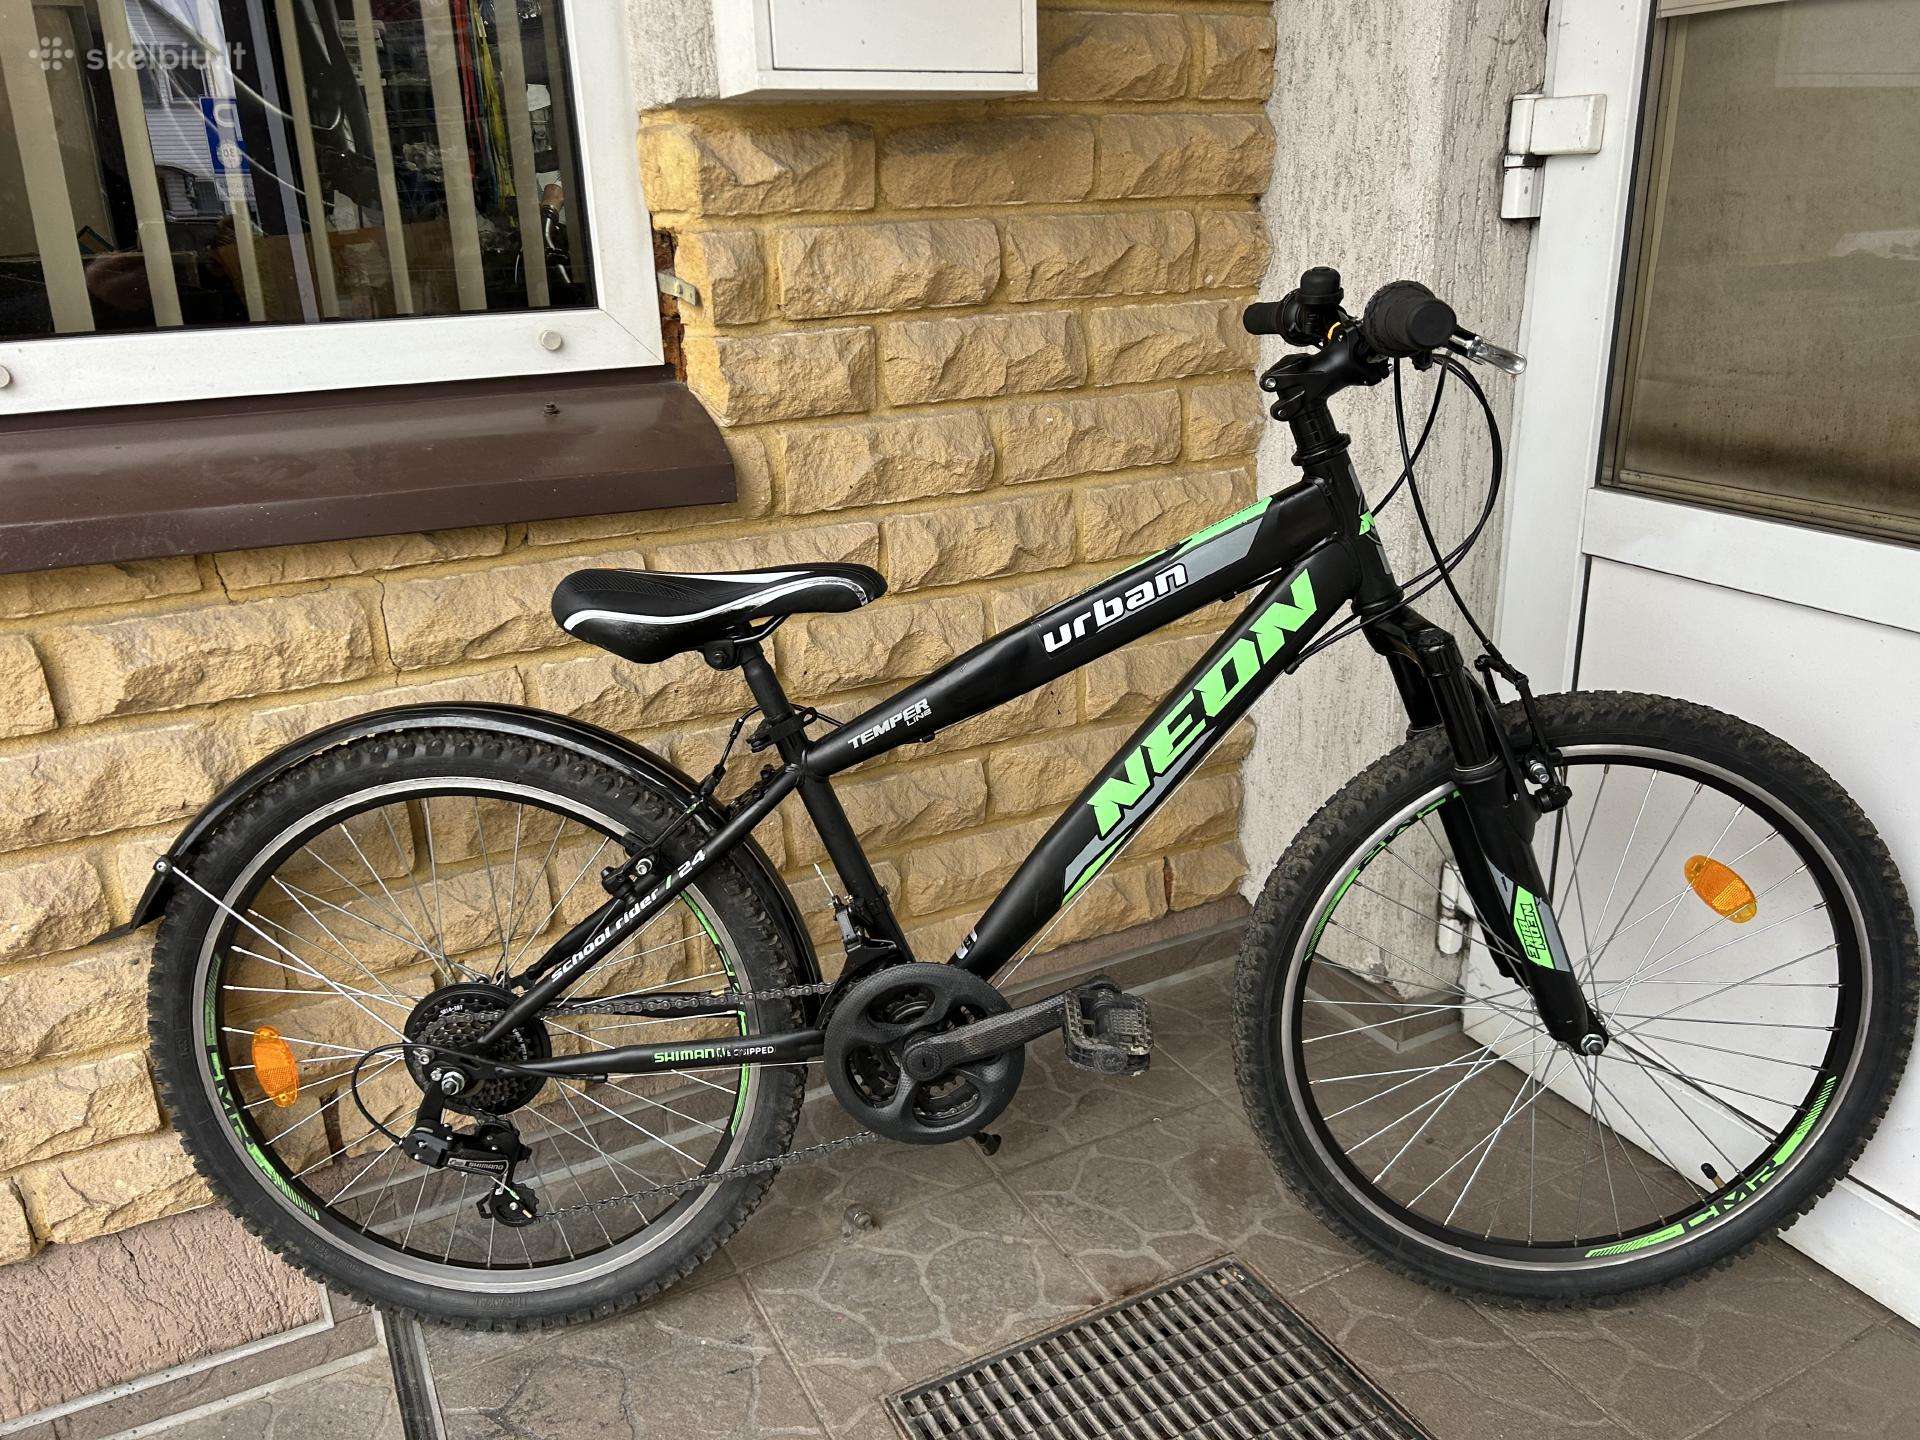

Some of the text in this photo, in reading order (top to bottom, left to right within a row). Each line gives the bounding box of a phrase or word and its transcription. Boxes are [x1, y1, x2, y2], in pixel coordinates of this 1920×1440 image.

[1042, 563, 1188, 653] urban
[847, 698, 930, 750] TEMPER
[906, 708, 932, 726] LINE
[1087, 568, 1318, 838] NEON
[551, 927, 611, 982] school
[615, 888, 660, 931] rider
[677, 849, 706, 879] 24
[1519, 902, 1547, 950] NEON
